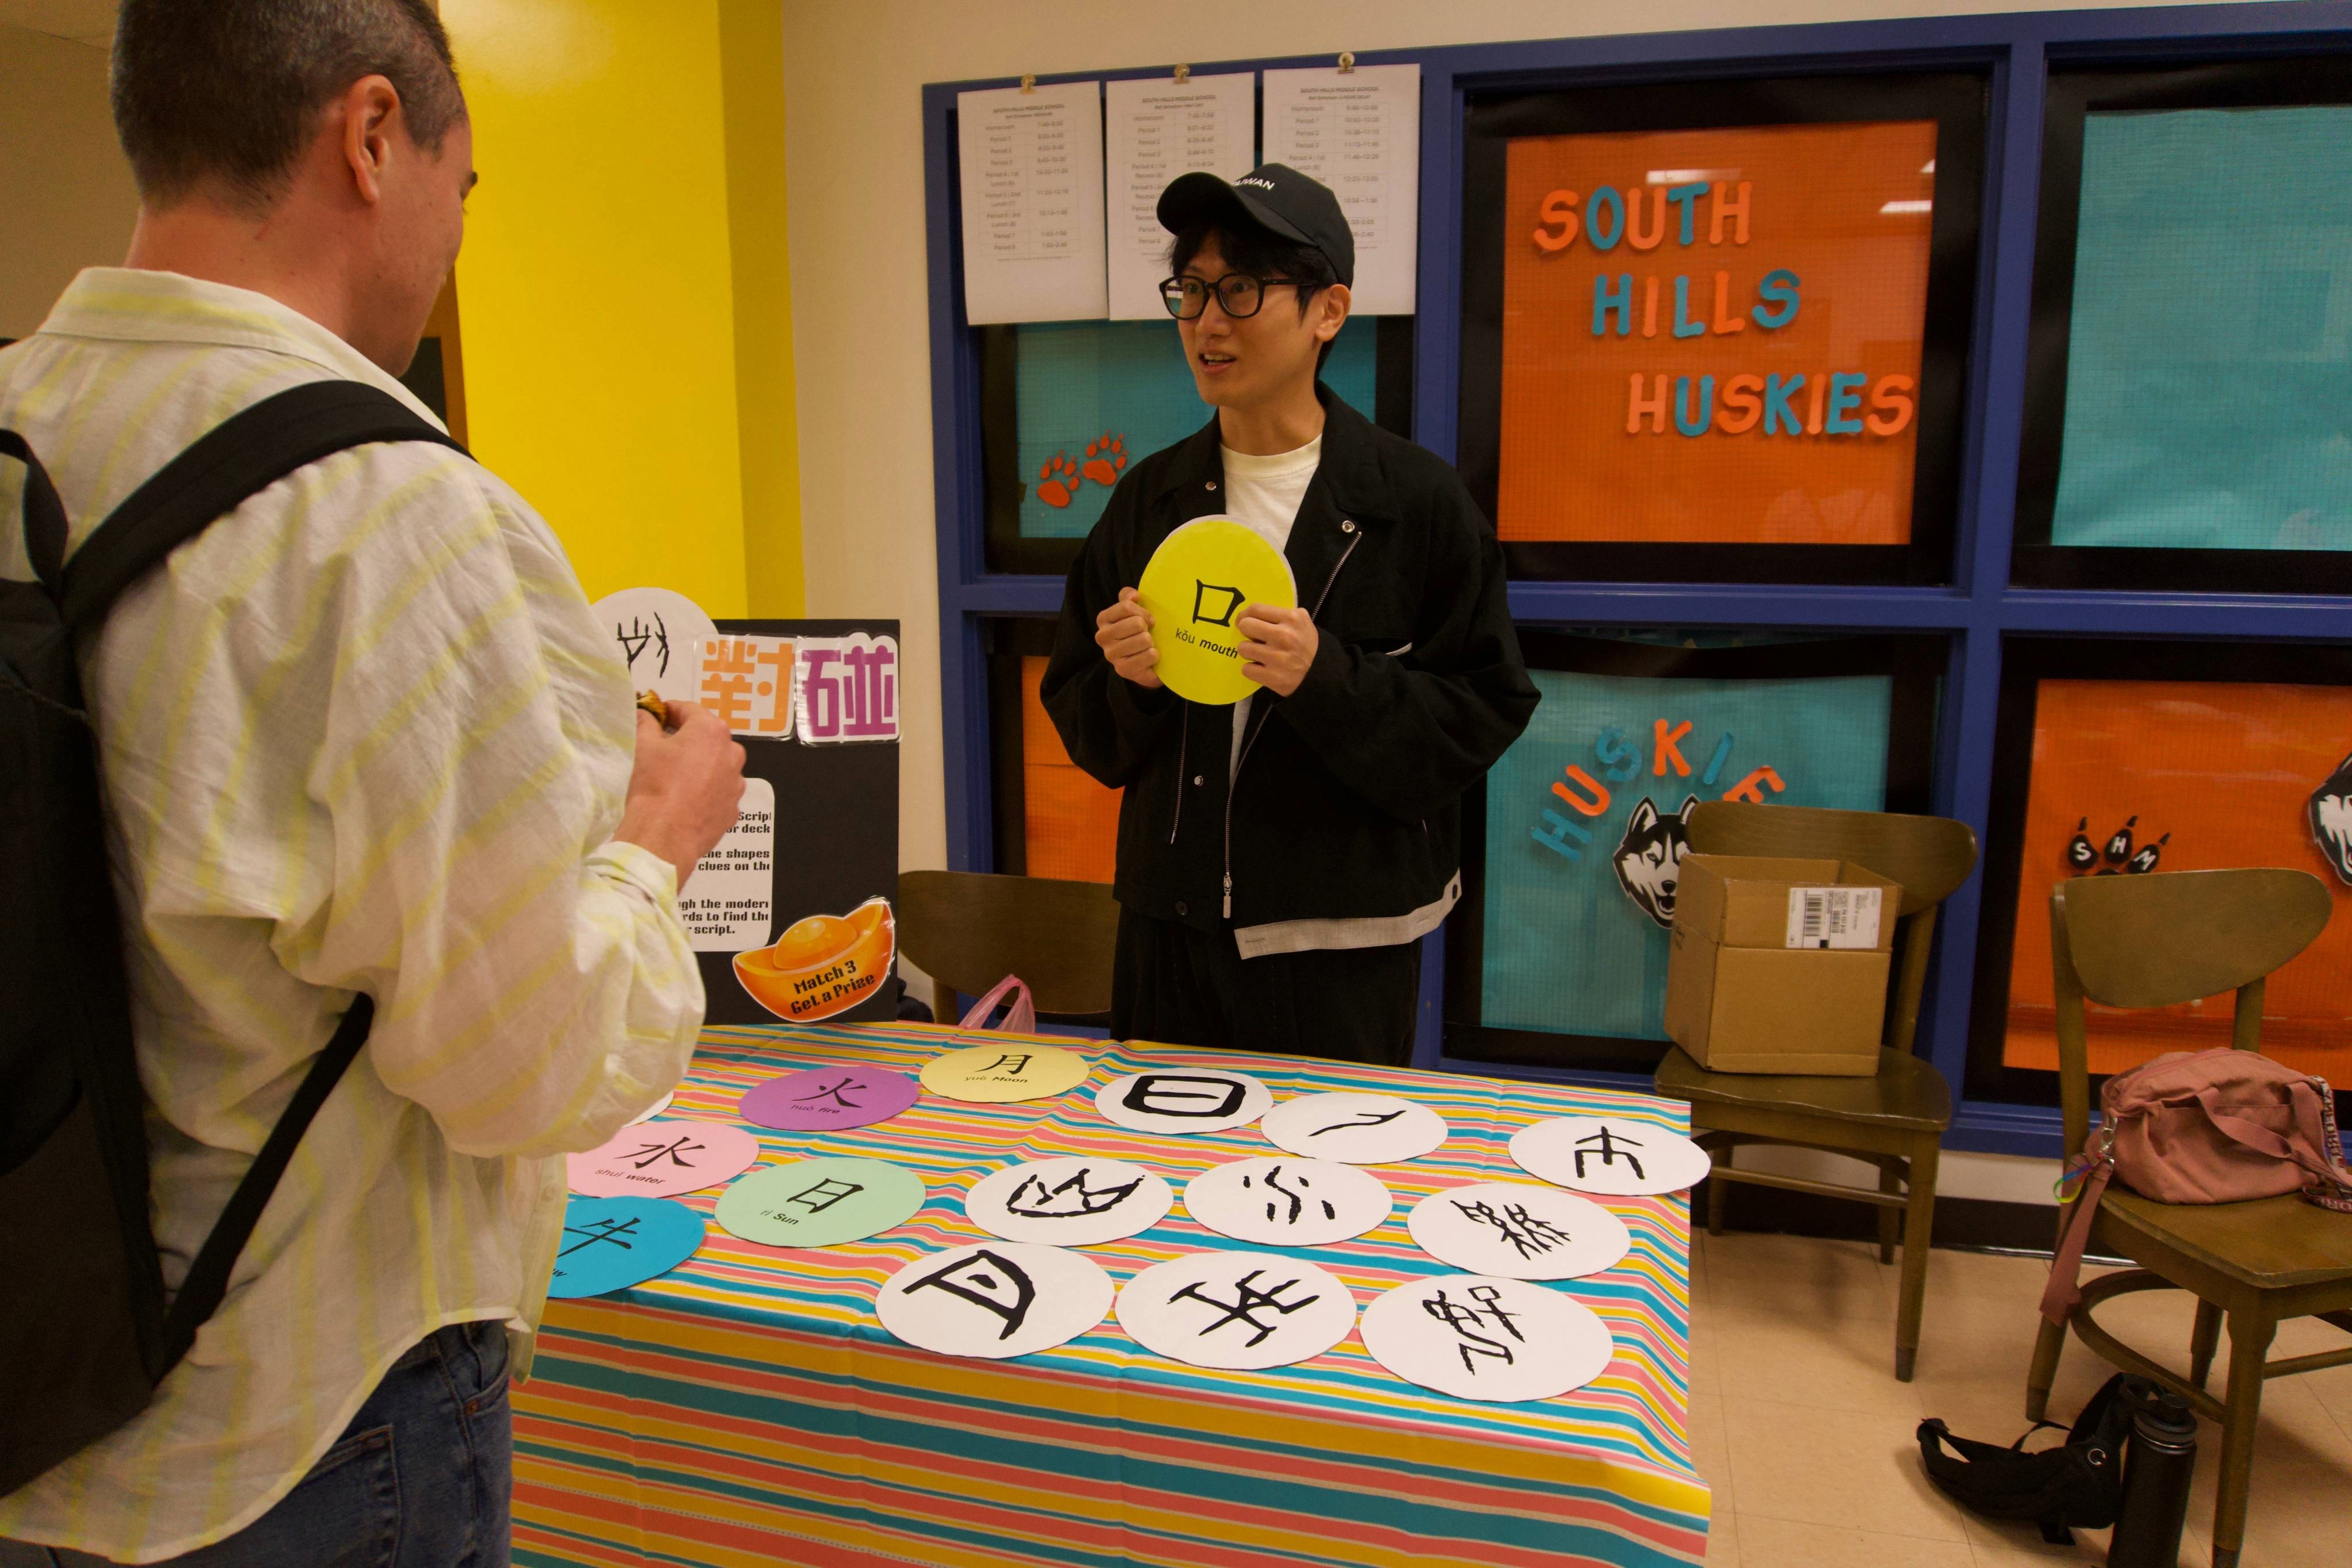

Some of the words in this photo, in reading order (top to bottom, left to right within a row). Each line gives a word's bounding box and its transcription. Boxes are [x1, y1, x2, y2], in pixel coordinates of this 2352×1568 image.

[1231, 178, 1275, 189] AIWAN
[1533, 180, 1752, 251] SOUTH
[1591, 269, 1801, 338] HILLS
[1627, 371, 1914, 437] HUSKIES
[1192, 579, 1246, 627] 口
[1199, 639, 1238, 659] mouth
[742, 824, 770, 833] deck
[727, 849, 770, 860] shapes
[698, 861, 730, 870] clues
[701, 899, 721, 908] the
[683, 912, 702, 921] rds
[707, 912, 719, 921] to
[723, 912, 747, 921] find
[694, 925, 735, 936] script.
[793, 966, 844, 994] Match
[844, 960, 857, 974] 3
[791, 995, 820, 1014] Get
[822, 991, 832, 1002] a
[833, 975, 875, 997] Prize
[974, 1054, 1034, 1075] 月
[792, 1078, 867, 1108] 火
[613, 1136, 705, 1169] 水
[626, 1174, 666, 1184] water
[786, 1178, 864, 1214] 日
[773, 1213, 799, 1225] Sun
